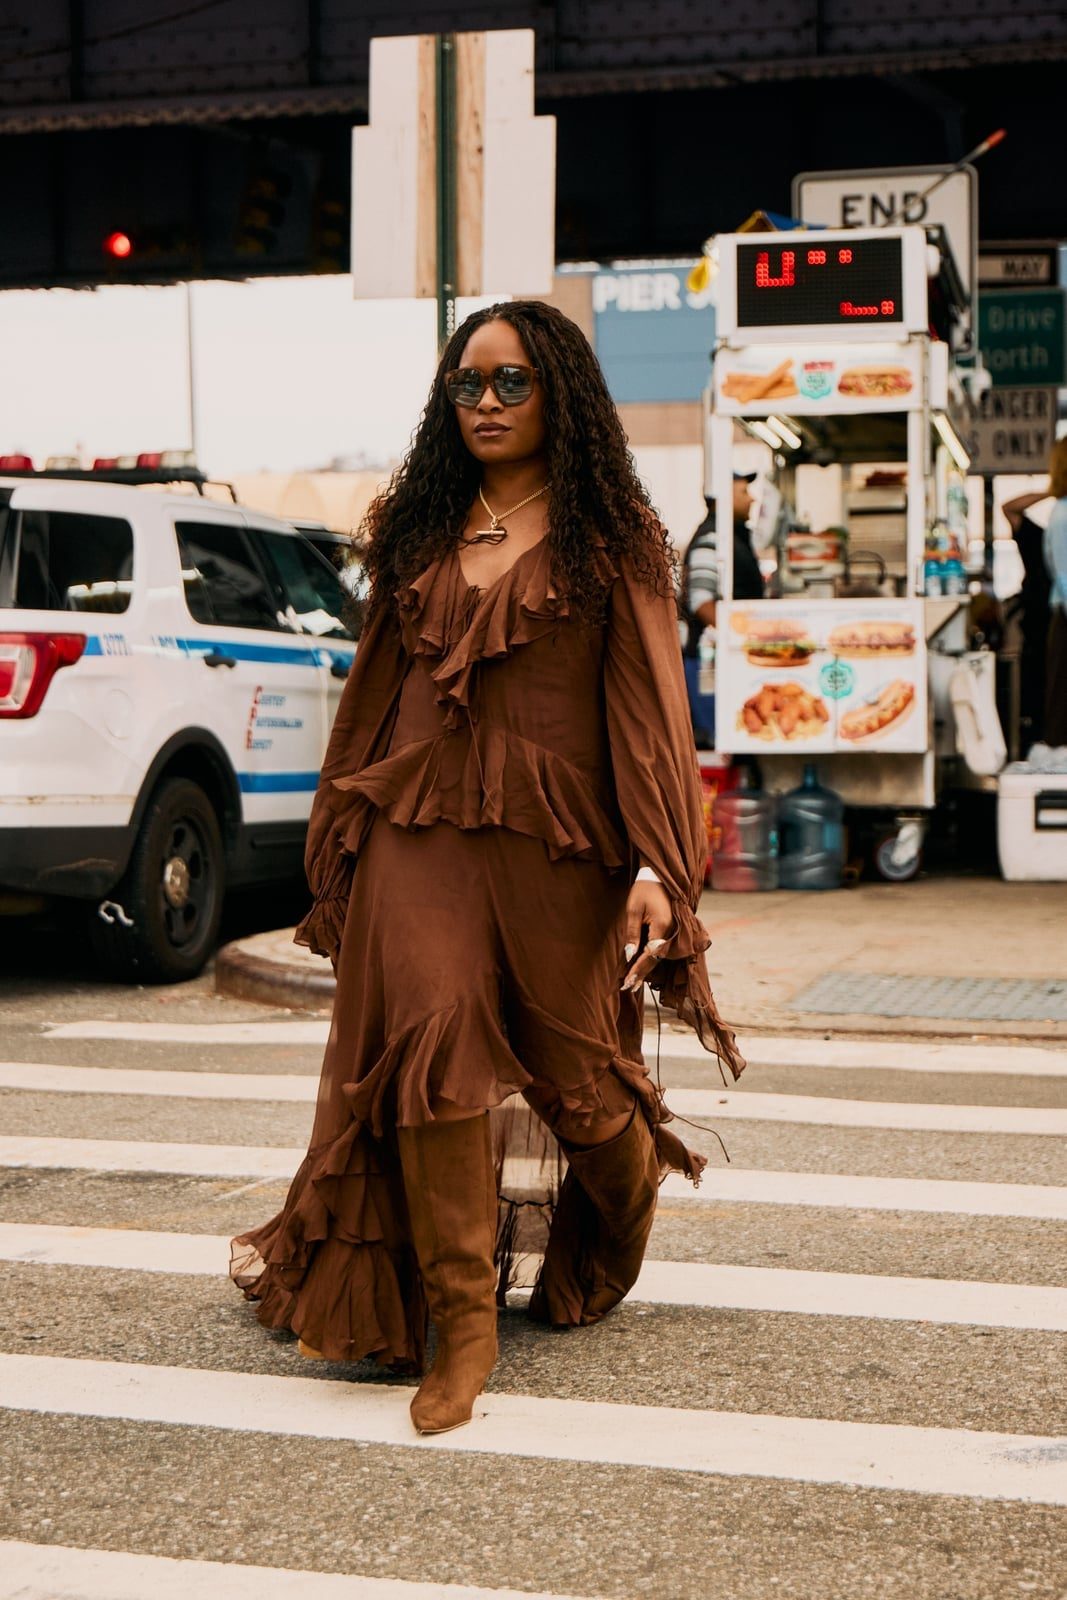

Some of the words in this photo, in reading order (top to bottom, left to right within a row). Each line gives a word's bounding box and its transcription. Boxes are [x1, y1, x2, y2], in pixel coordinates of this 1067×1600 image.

[841, 192, 928, 226] END
[593, 273, 682, 312] PIER
[988, 303, 1056, 332] Drive
[993, 430, 1046, 459] ONLY
